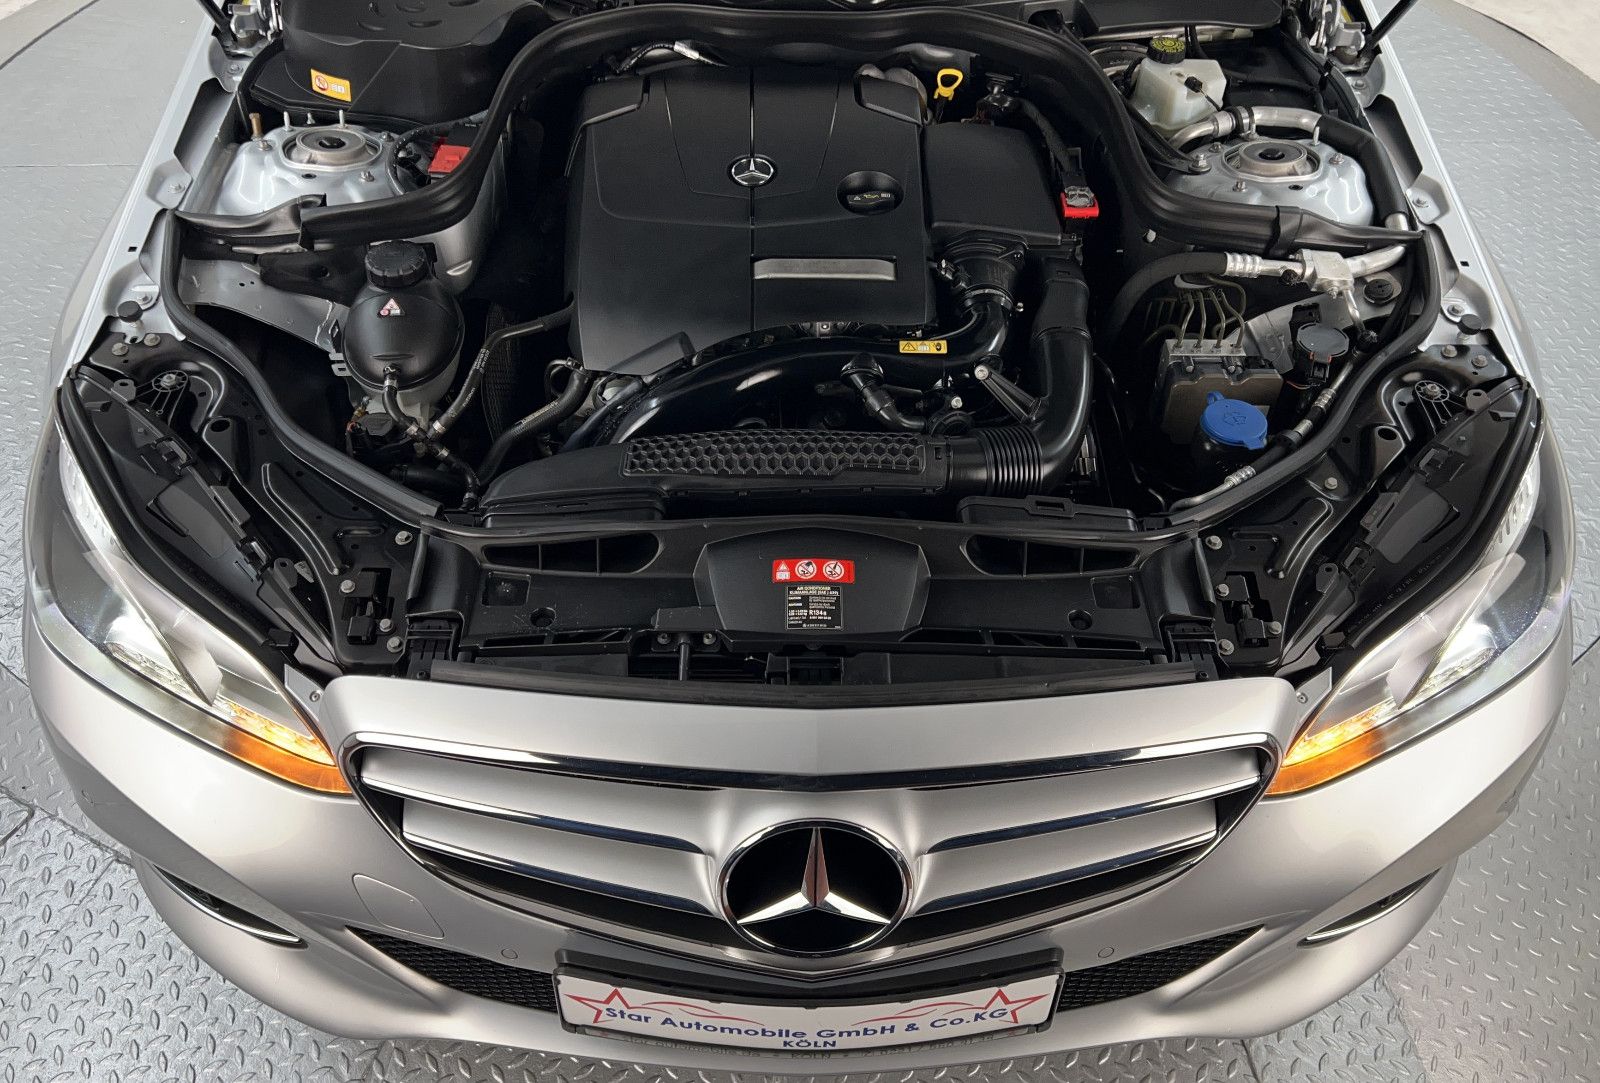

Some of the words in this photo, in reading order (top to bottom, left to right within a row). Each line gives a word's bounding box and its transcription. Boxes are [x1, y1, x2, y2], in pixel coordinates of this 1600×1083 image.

[605, 1007, 652, 1023] Star
[660, 1017, 808, 1039] Automobile
[816, 1024, 896, 1038] GmbH
[904, 1023, 920, 1032] &
[929, 1008, 1008, 1029] Co.KG
[782, 1039, 837, 1048] KÖLN
